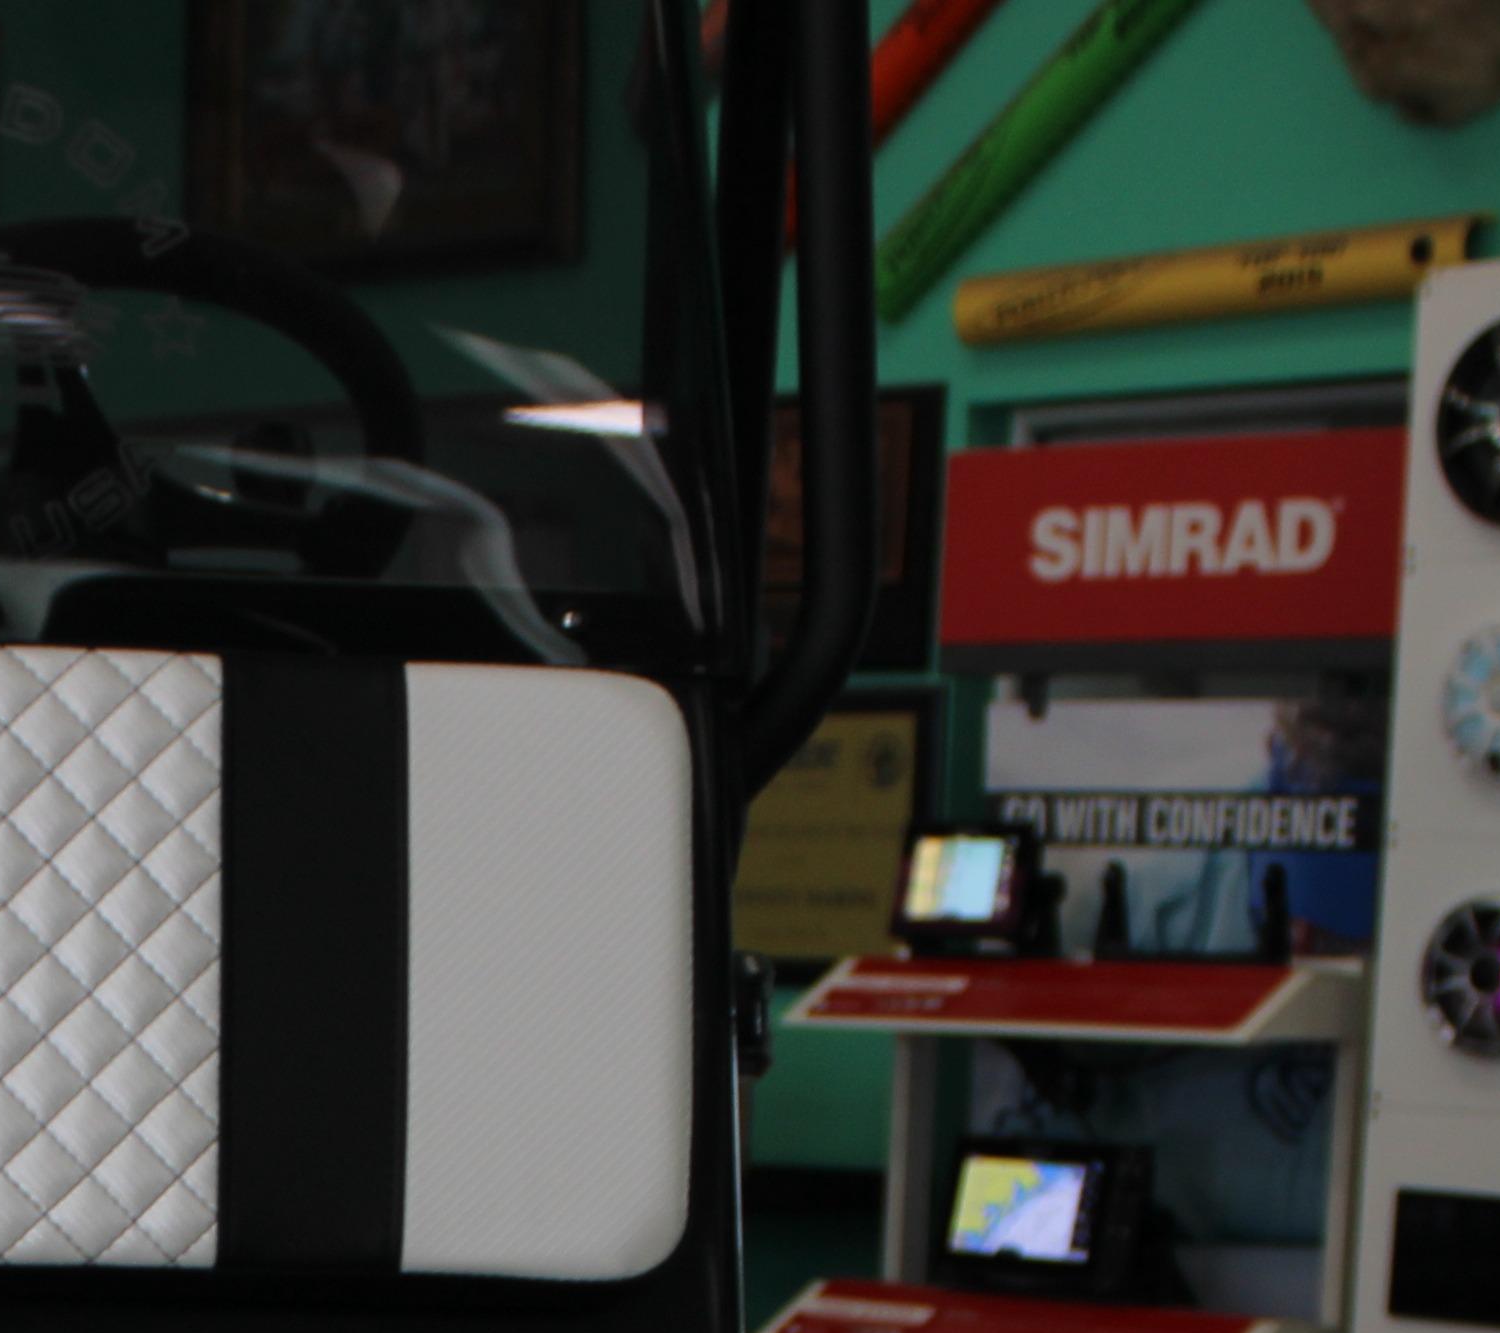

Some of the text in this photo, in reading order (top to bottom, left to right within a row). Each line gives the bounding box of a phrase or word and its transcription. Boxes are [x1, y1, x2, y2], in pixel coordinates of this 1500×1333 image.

[1028, 498, 1337, 584] SIMRAD
[1055, 796, 1138, 843] WITH
[1146, 796, 1358, 848] CONFIDENCE
